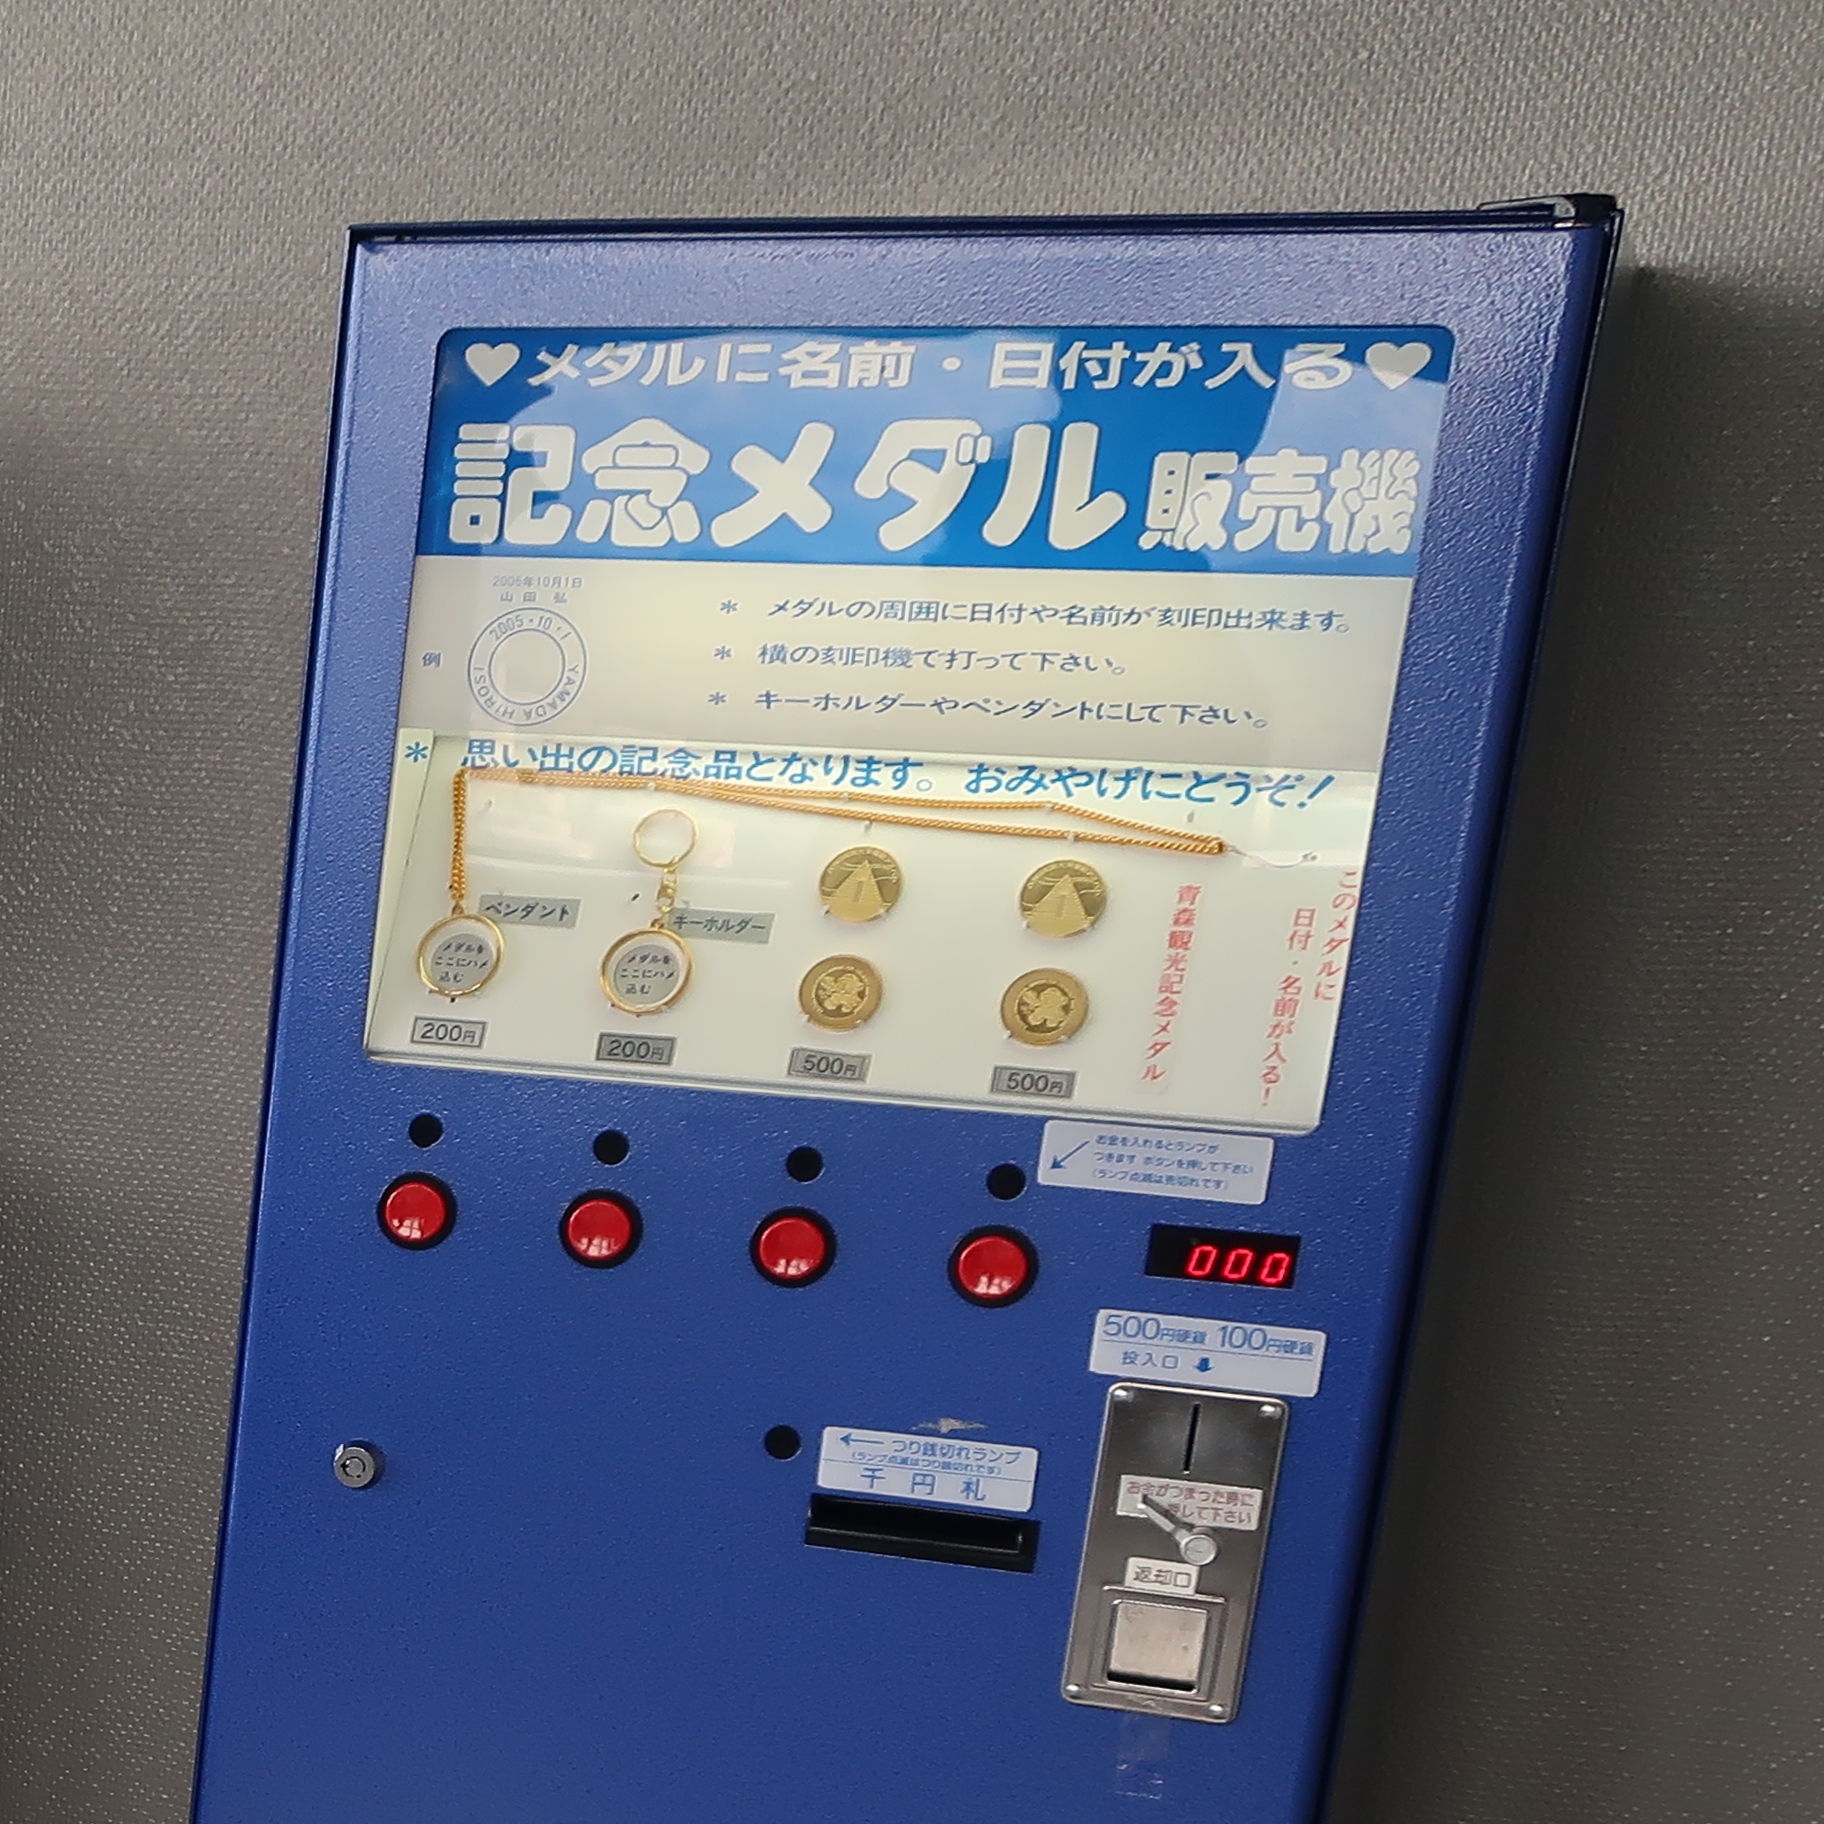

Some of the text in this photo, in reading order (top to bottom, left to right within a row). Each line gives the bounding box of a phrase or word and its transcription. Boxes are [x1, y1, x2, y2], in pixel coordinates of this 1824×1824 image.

[526, 340, 1355, 390] メダルに名前・日付が入る
[448, 416, 1422, 555] 記念メダル 販売機
[767, 596, 1353, 635] メダルの周囲に日付や名前が刻印出来ます。
[756, 642, 1128, 677] 横の刻印機で打って下さい。
[754, 689, 1270, 730] キーホルダーやペンダントにして下さい。
[458, 737, 934, 793] 思い出の記念品となります。
[481, 899, 572, 921] ペンダント
[673, 914, 768, 935] キーホルダー
[1140, 883, 1202, 1082] 青森観光記念メダル
[420, 1022, 477, 1044] 200円
[605, 1038, 665, 1061] 200円
[802, 1053, 858, 1077] 500円
[1005, 1072, 1064, 1095] 500円
[1185, 1244, 1292, 1284] 000
[1121, 1350, 1180, 1370] 投入口
